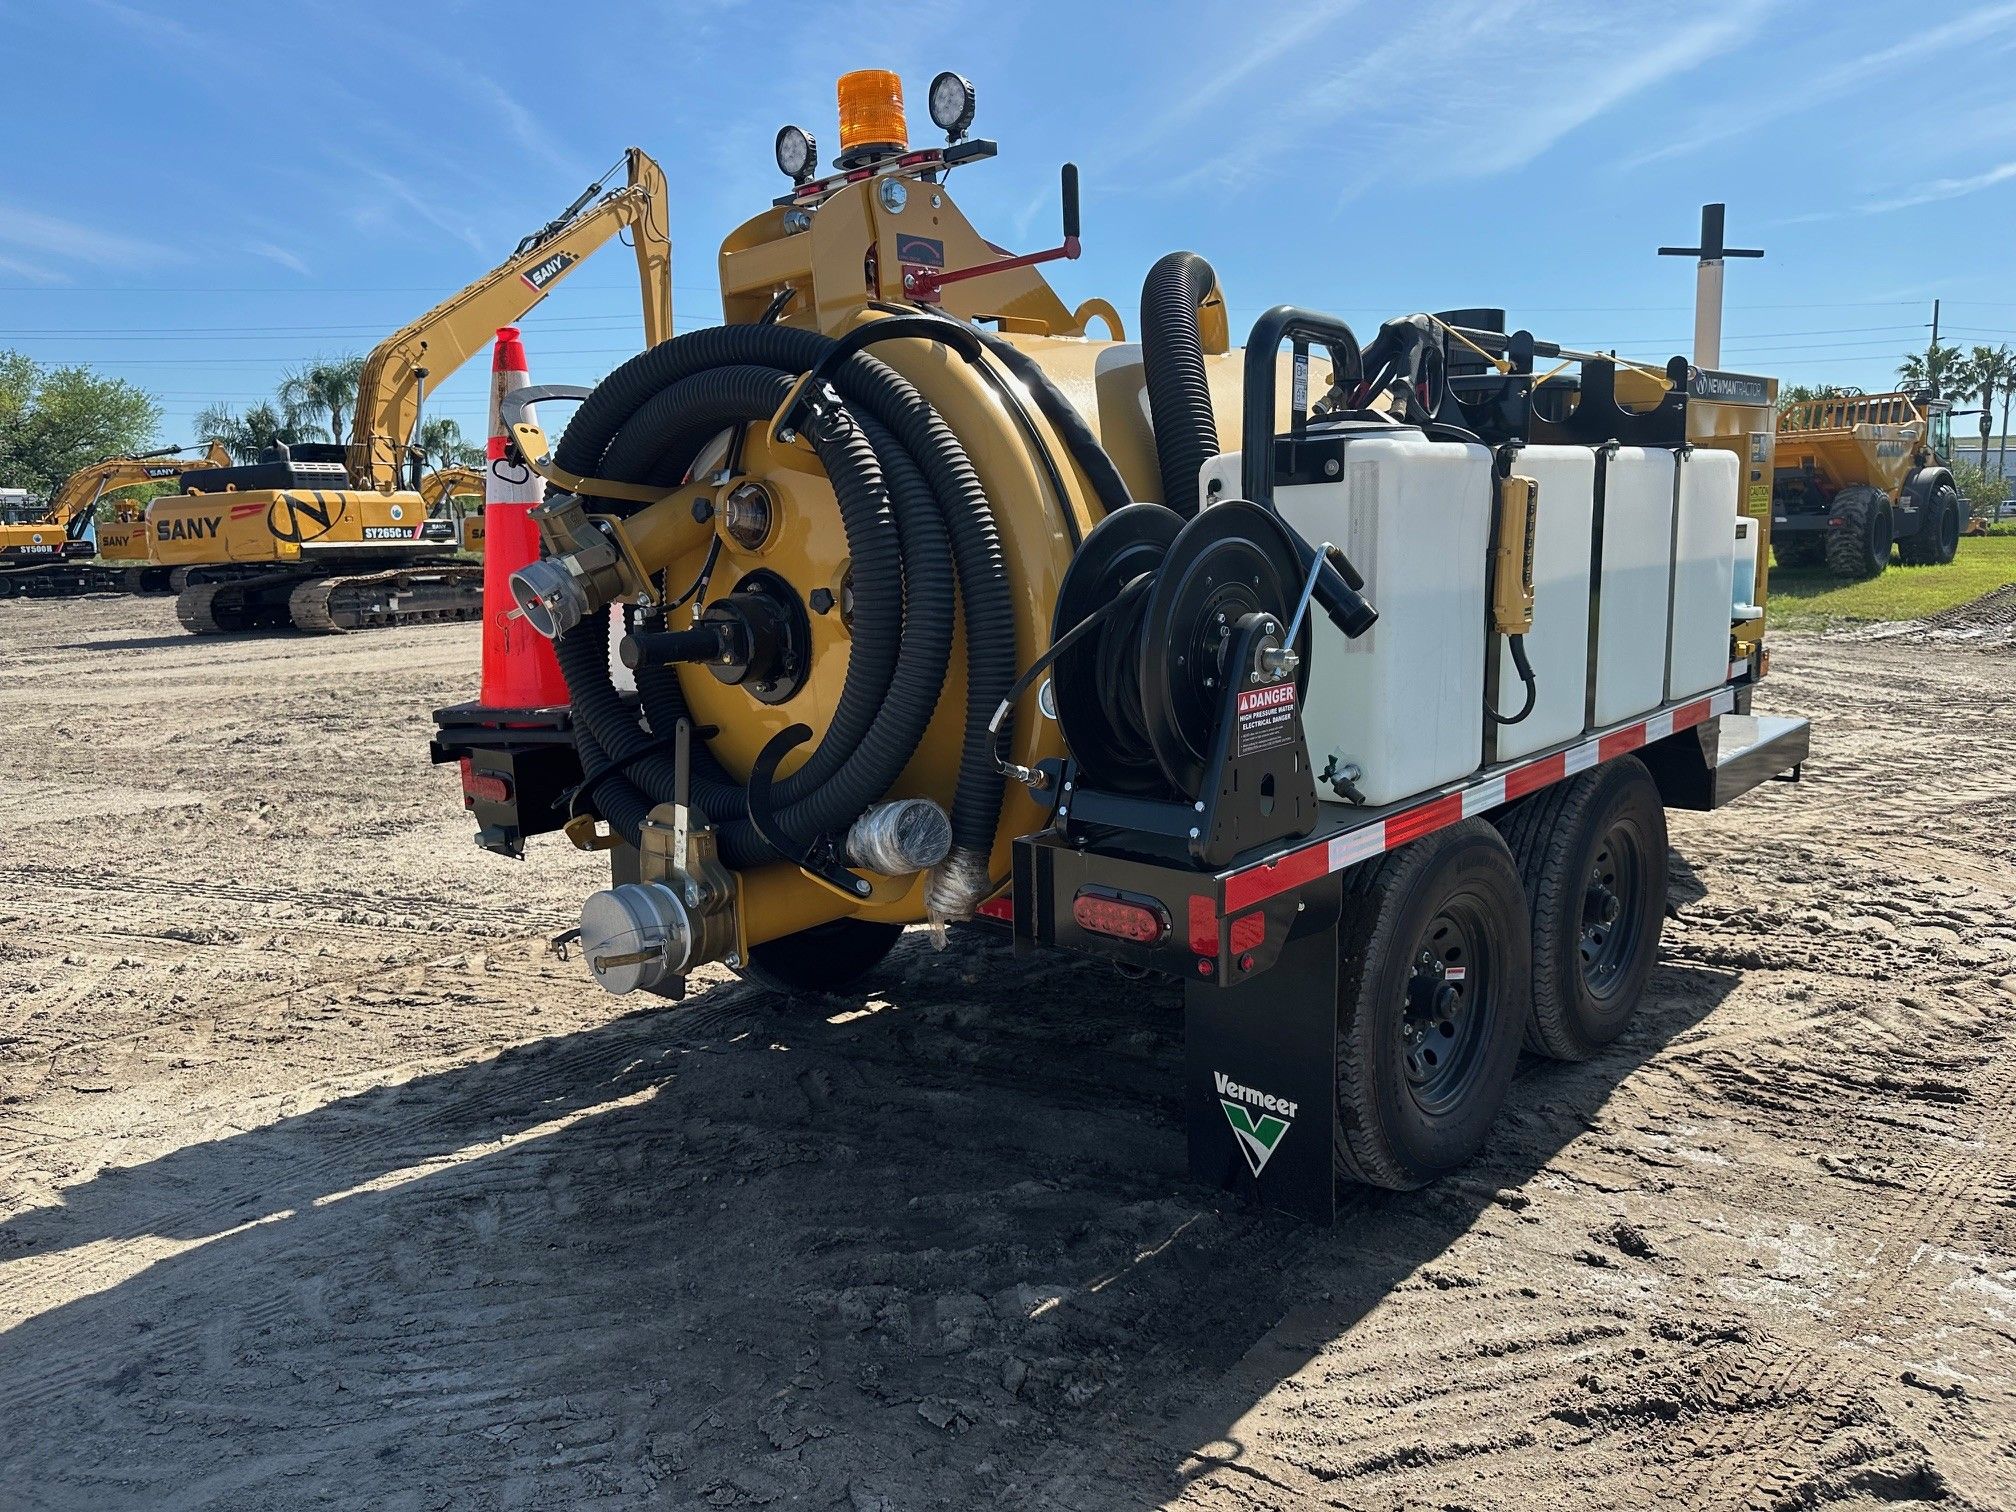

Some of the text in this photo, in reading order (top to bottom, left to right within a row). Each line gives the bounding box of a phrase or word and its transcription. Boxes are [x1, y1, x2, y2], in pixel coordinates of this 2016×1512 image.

[532, 255, 562, 285] SANY
[150, 468, 175, 476] SANY
[157, 516, 222, 541] SANY
[365, 528, 402, 538] SY265C
[20, 545, 53, 553] SY500H
[103, 536, 129, 546] SANY
[1250, 686, 1294, 708] DANGER
[1240, 704, 1294, 722] HIGH PRESSURE WATER
[1243, 713, 1291, 730] ELECTRICAL DANGER
[1214, 1071, 1298, 1117] Vermeer
